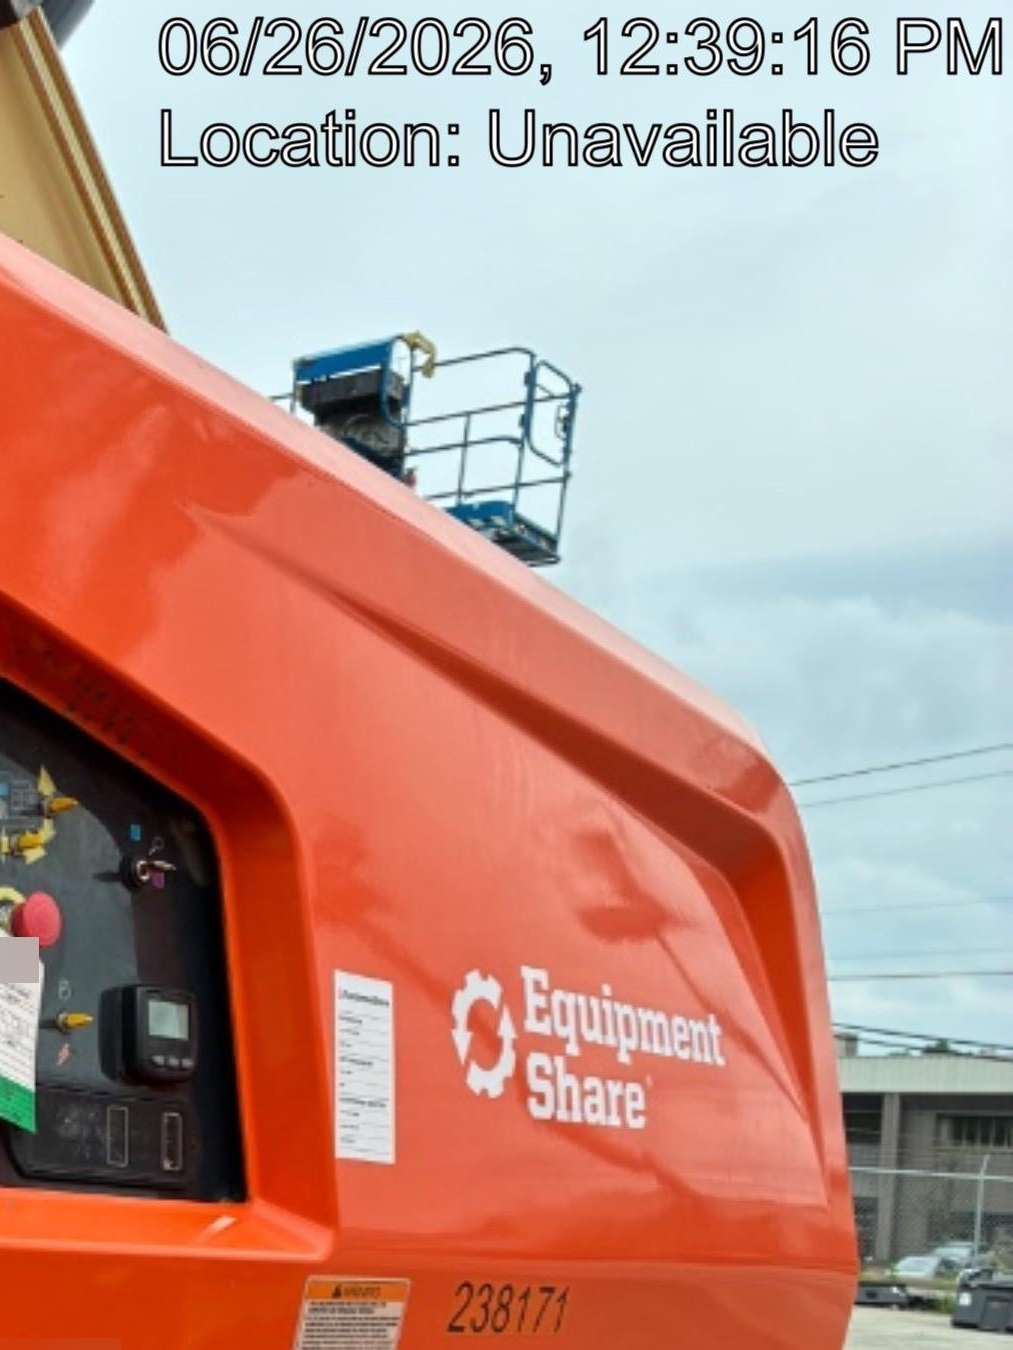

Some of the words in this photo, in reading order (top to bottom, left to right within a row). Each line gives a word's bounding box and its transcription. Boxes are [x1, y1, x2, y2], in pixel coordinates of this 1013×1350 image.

[520, 965, 726, 1066] Equipment
[526, 1052, 648, 1129] Share
[447, 1281, 568, 1334] 238171
